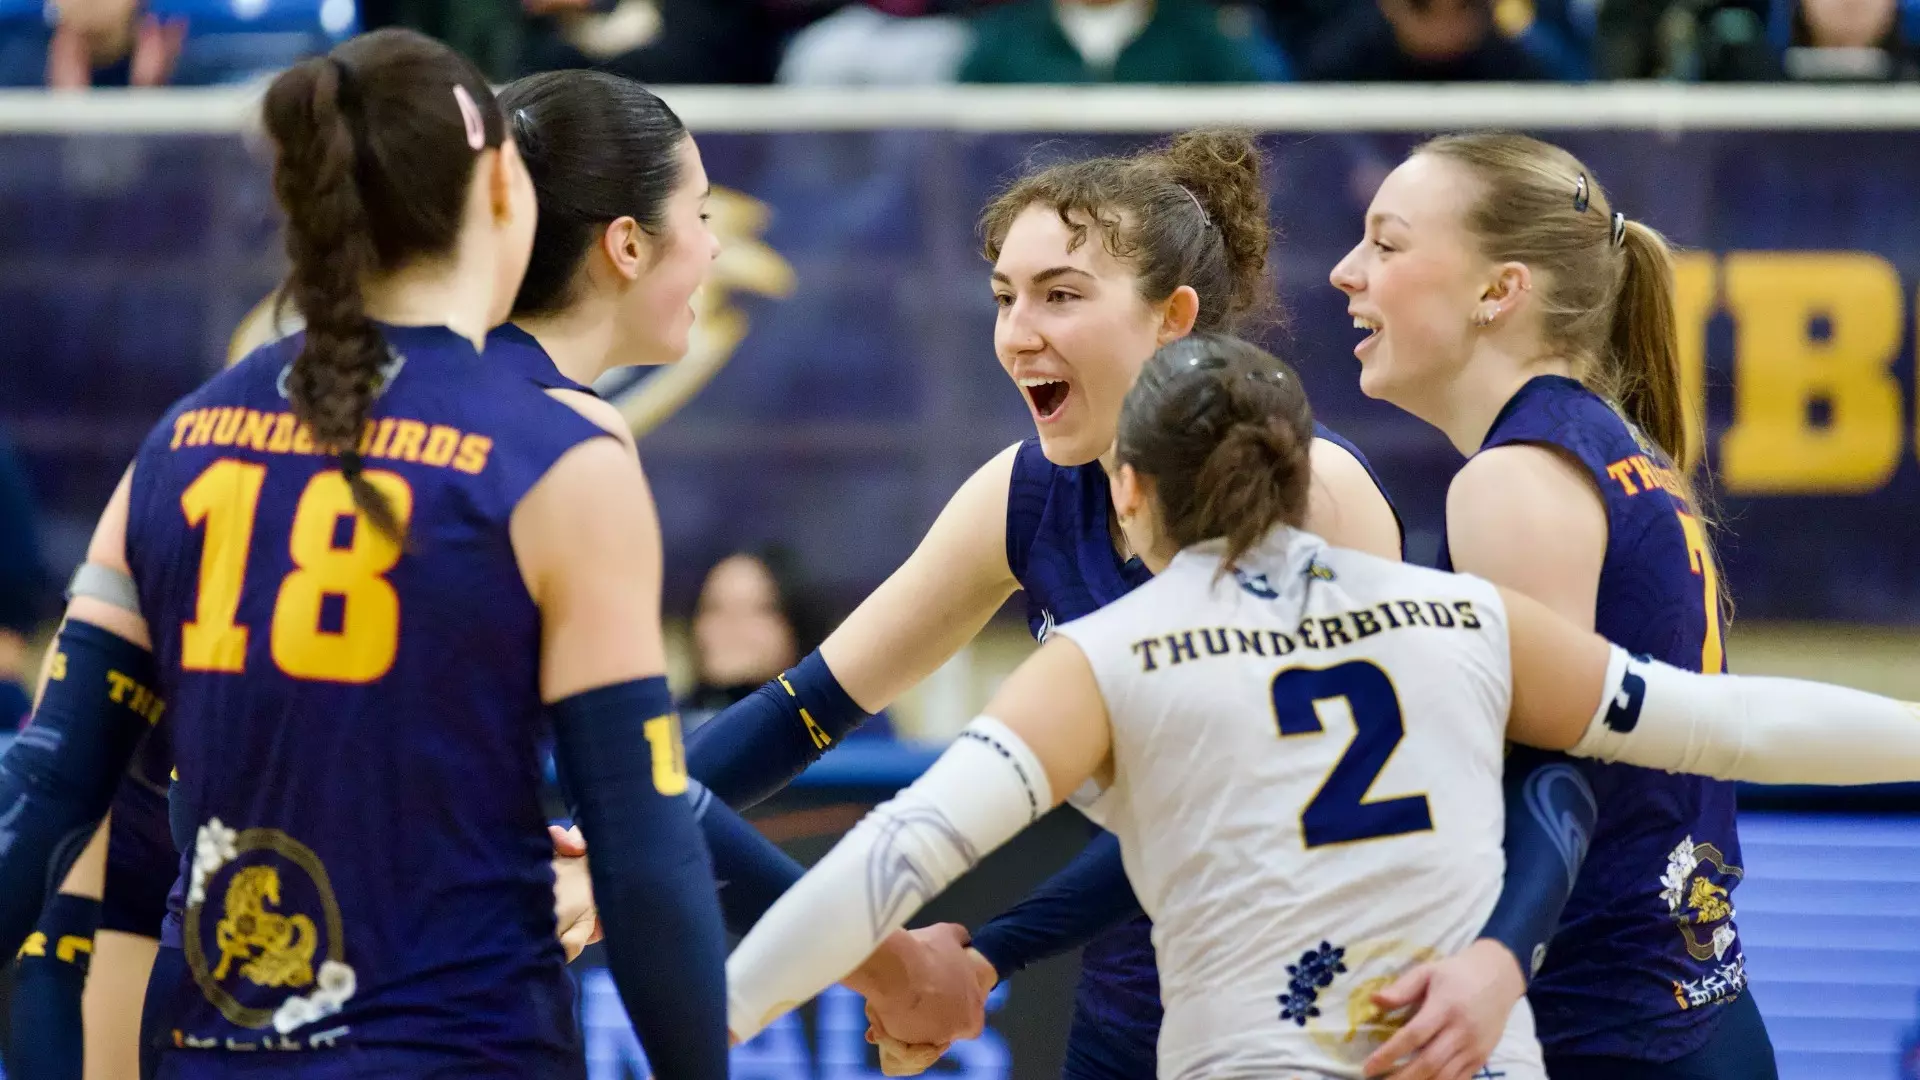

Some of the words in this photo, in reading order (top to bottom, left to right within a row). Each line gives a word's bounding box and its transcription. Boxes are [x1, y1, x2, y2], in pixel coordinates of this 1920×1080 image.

[180, 457, 415, 684] 18
[1132, 600, 1482, 673] THUNDERBIRDS
[1268, 657, 1436, 850] 2
